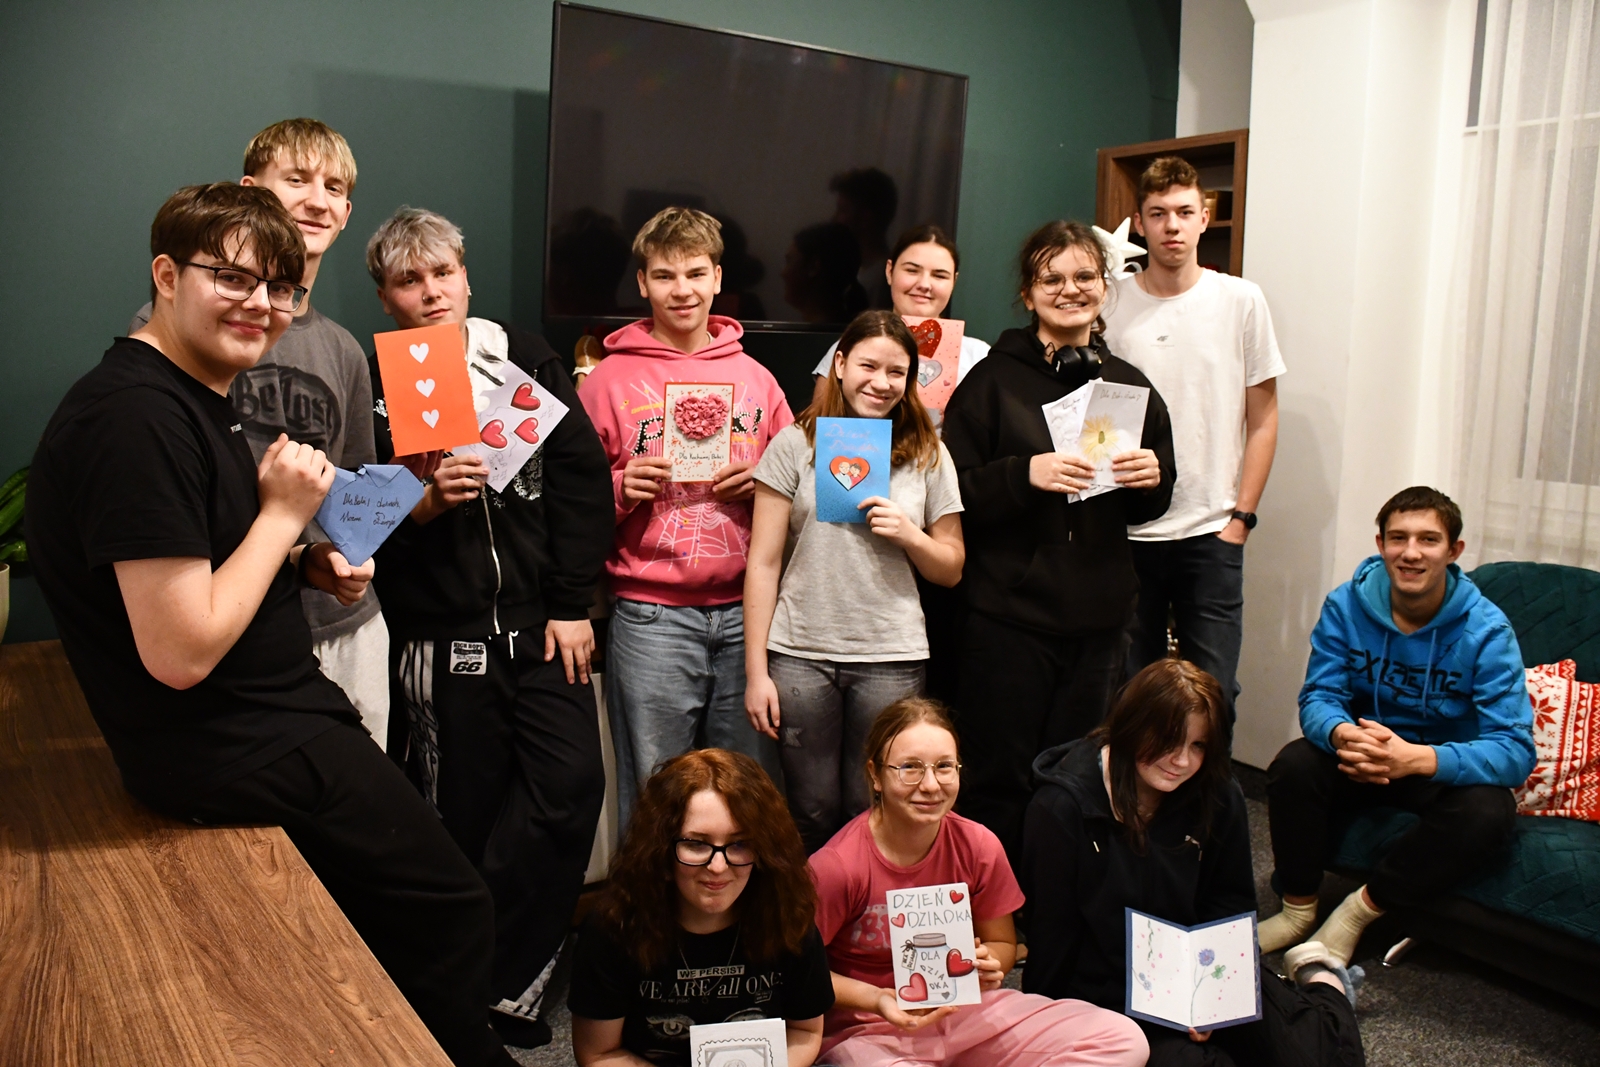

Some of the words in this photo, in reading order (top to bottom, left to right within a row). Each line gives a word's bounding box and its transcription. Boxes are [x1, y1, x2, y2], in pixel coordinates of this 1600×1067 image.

[678, 452, 688, 460] Dla
[452, 661, 483, 673] 66
[893, 888, 944, 909] DZIEŃ
[907, 909, 973, 928] DZIADKA
[920, 950, 941, 961] DLA
[679, 970, 697, 979] WE
[699, 965, 744, 977] PERSIST
[919, 964, 945, 981] DZIA
[667, 978, 711, 997] ARE
[717, 977, 741, 997] all
[928, 981, 949, 991] DKA
